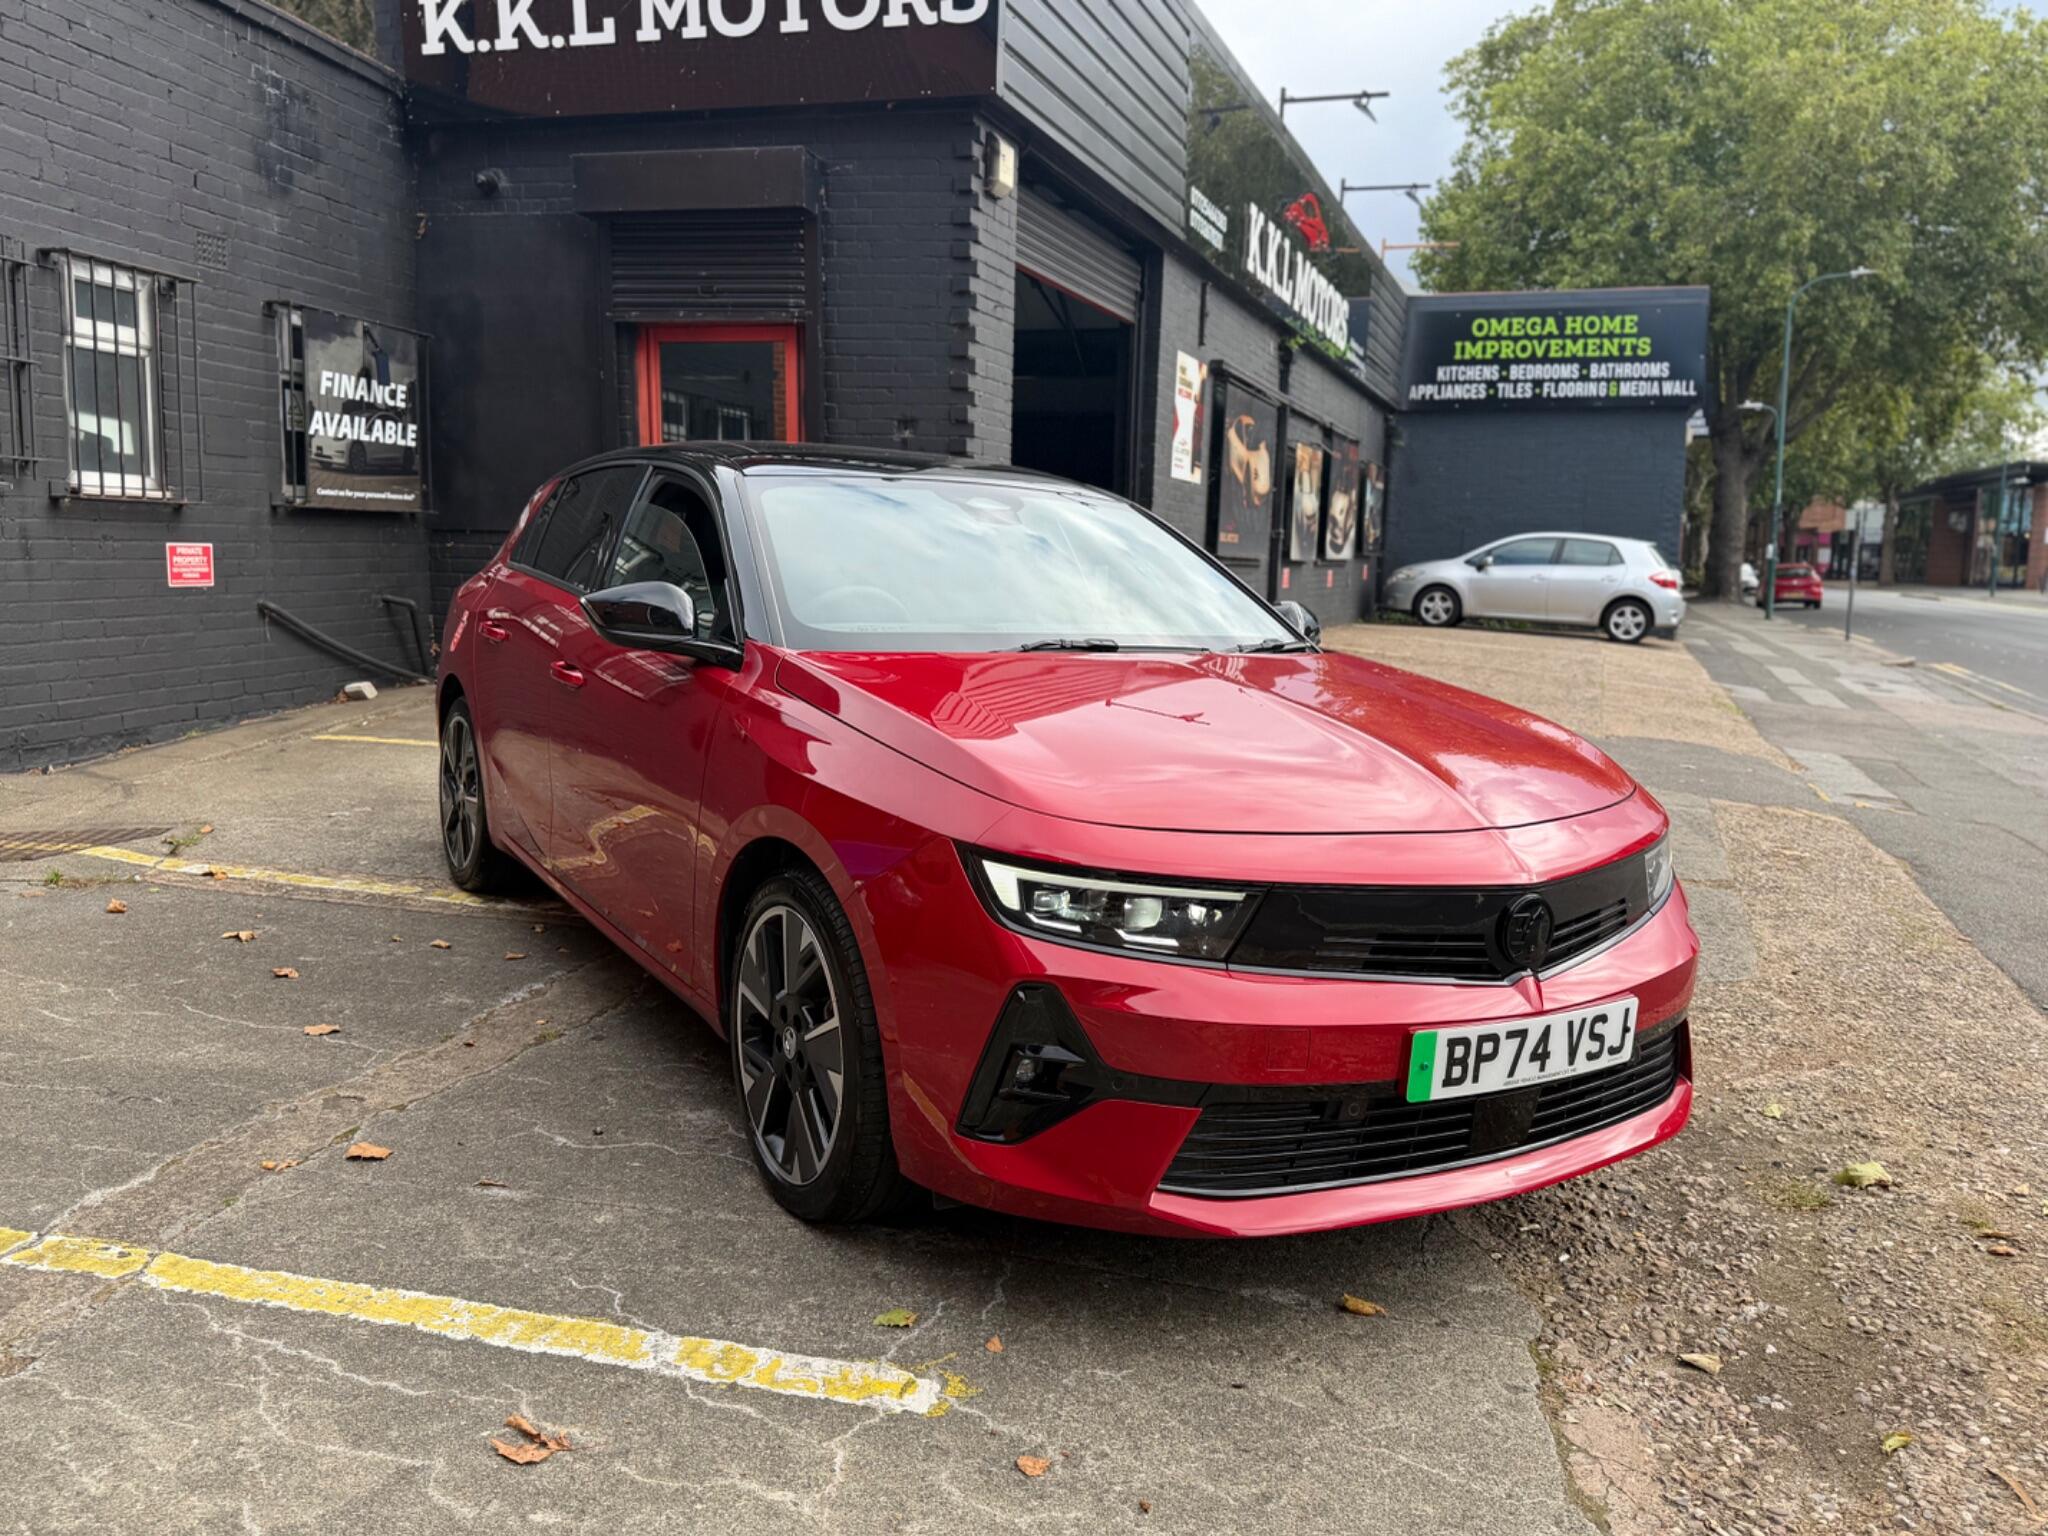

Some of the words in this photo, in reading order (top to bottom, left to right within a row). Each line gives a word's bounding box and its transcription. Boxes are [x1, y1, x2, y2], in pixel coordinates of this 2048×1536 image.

[417, 0, 616, 55] K.K.L
[1293, 250, 1350, 351] MOTORS
[1471, 316, 1559, 338] OMEGA
[1565, 315, 1639, 335] HOME
[1454, 337, 1652, 360] IMPROVEMENTS
[319, 370, 407, 408] FINANCE
[1409, 382, 1487, 400] APPLIANCES
[1496, 382, 1533, 399] TILES
[1542, 380, 1607, 398] FLOORING
[1619, 379, 1660, 396] MEDIA
[1661, 379, 1697, 396] WALL
[1436, 364, 1500, 382] KITCHENS
[1509, 362, 1580, 380] BEDROOMS
[1589, 361, 1670, 379] BATHROOMS
[308, 410, 418, 447] AVAILABLE
[1442, 1023, 1552, 1088] BP74
[1567, 1007, 1631, 1067] VSJ
